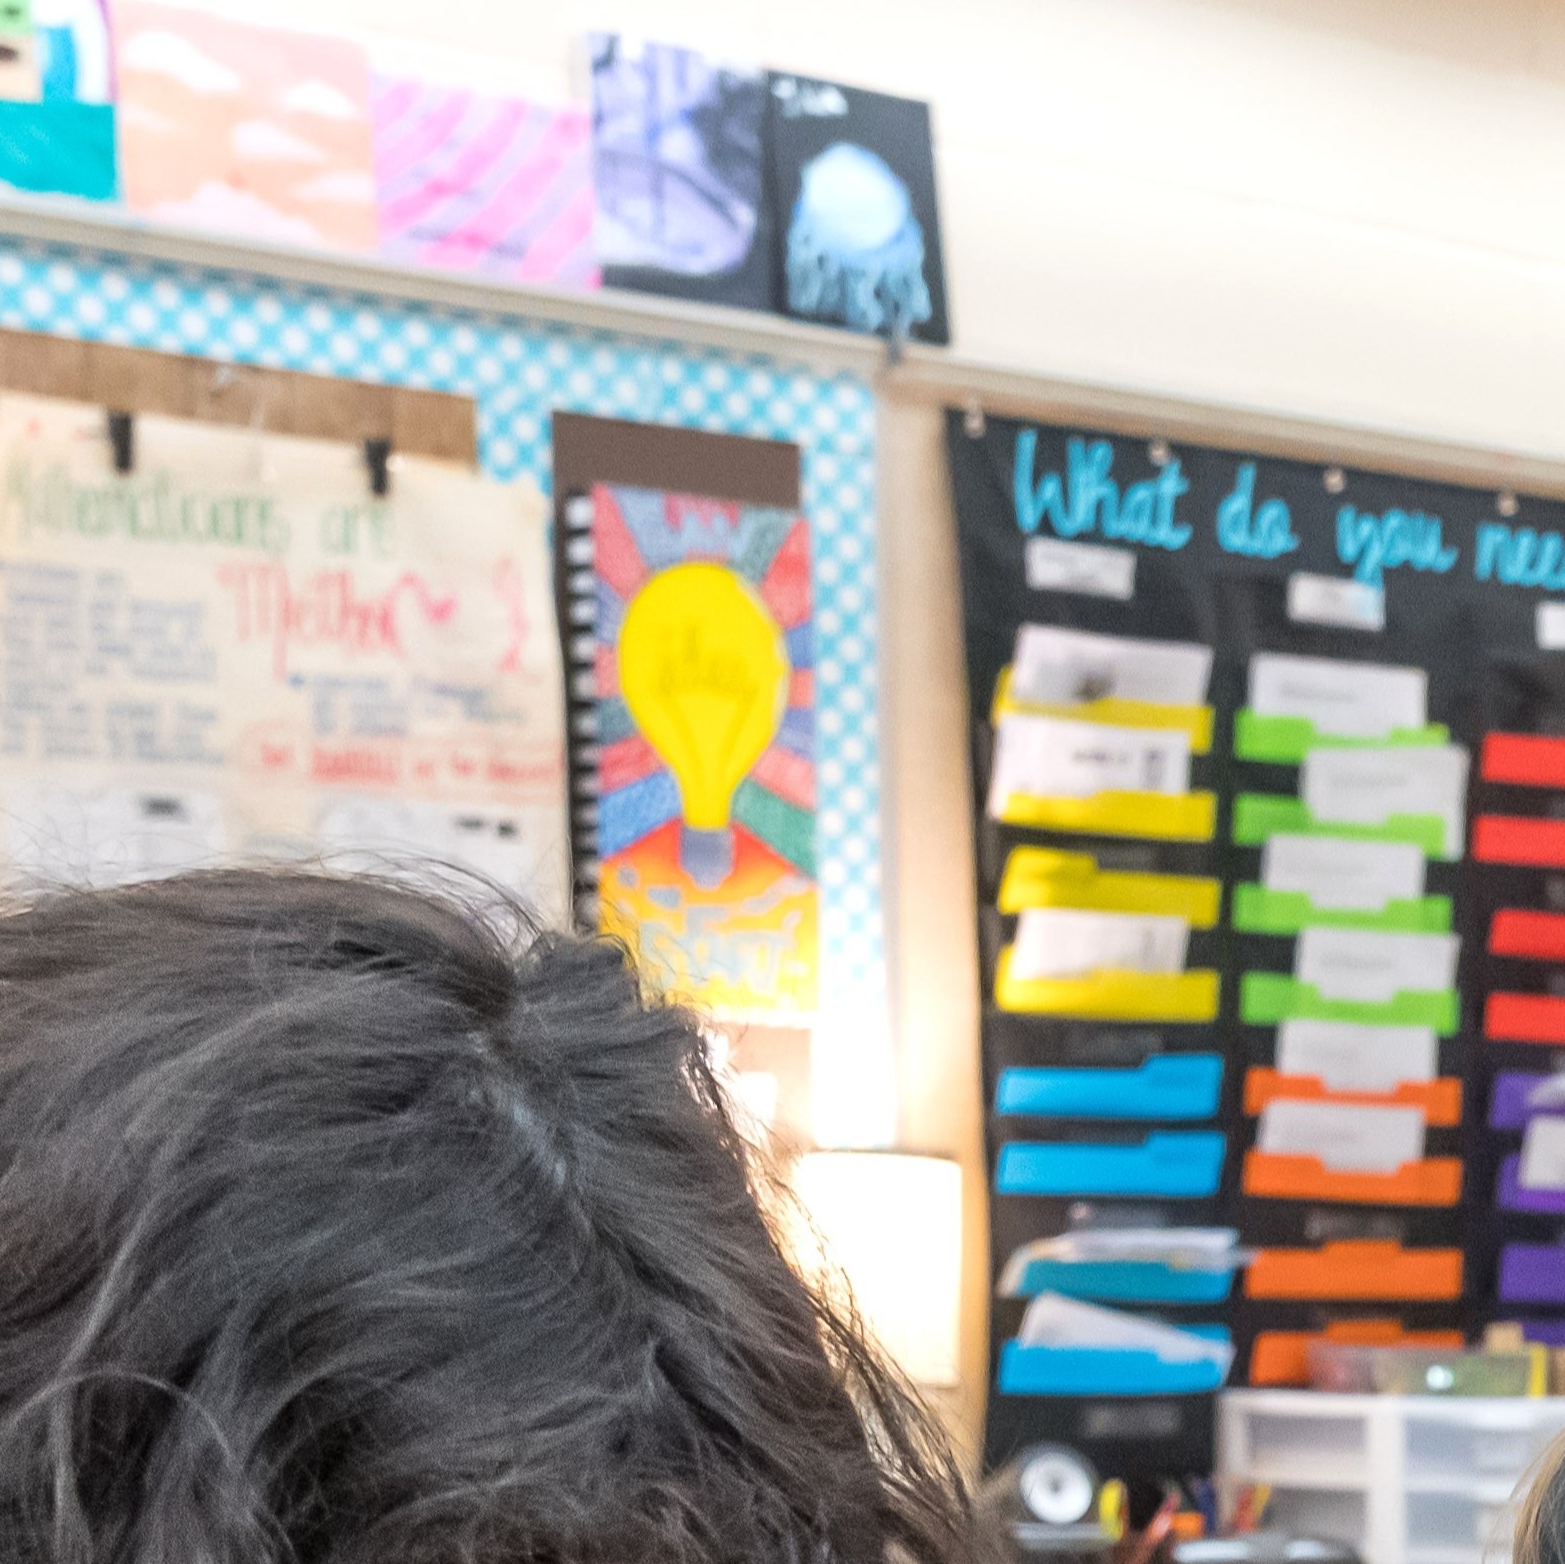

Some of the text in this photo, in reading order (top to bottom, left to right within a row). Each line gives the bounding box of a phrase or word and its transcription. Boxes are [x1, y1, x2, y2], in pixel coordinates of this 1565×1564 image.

[1013, 429, 1193, 551] What
[1215, 462, 1299, 560] do
[1336, 502, 1458, 612] you
